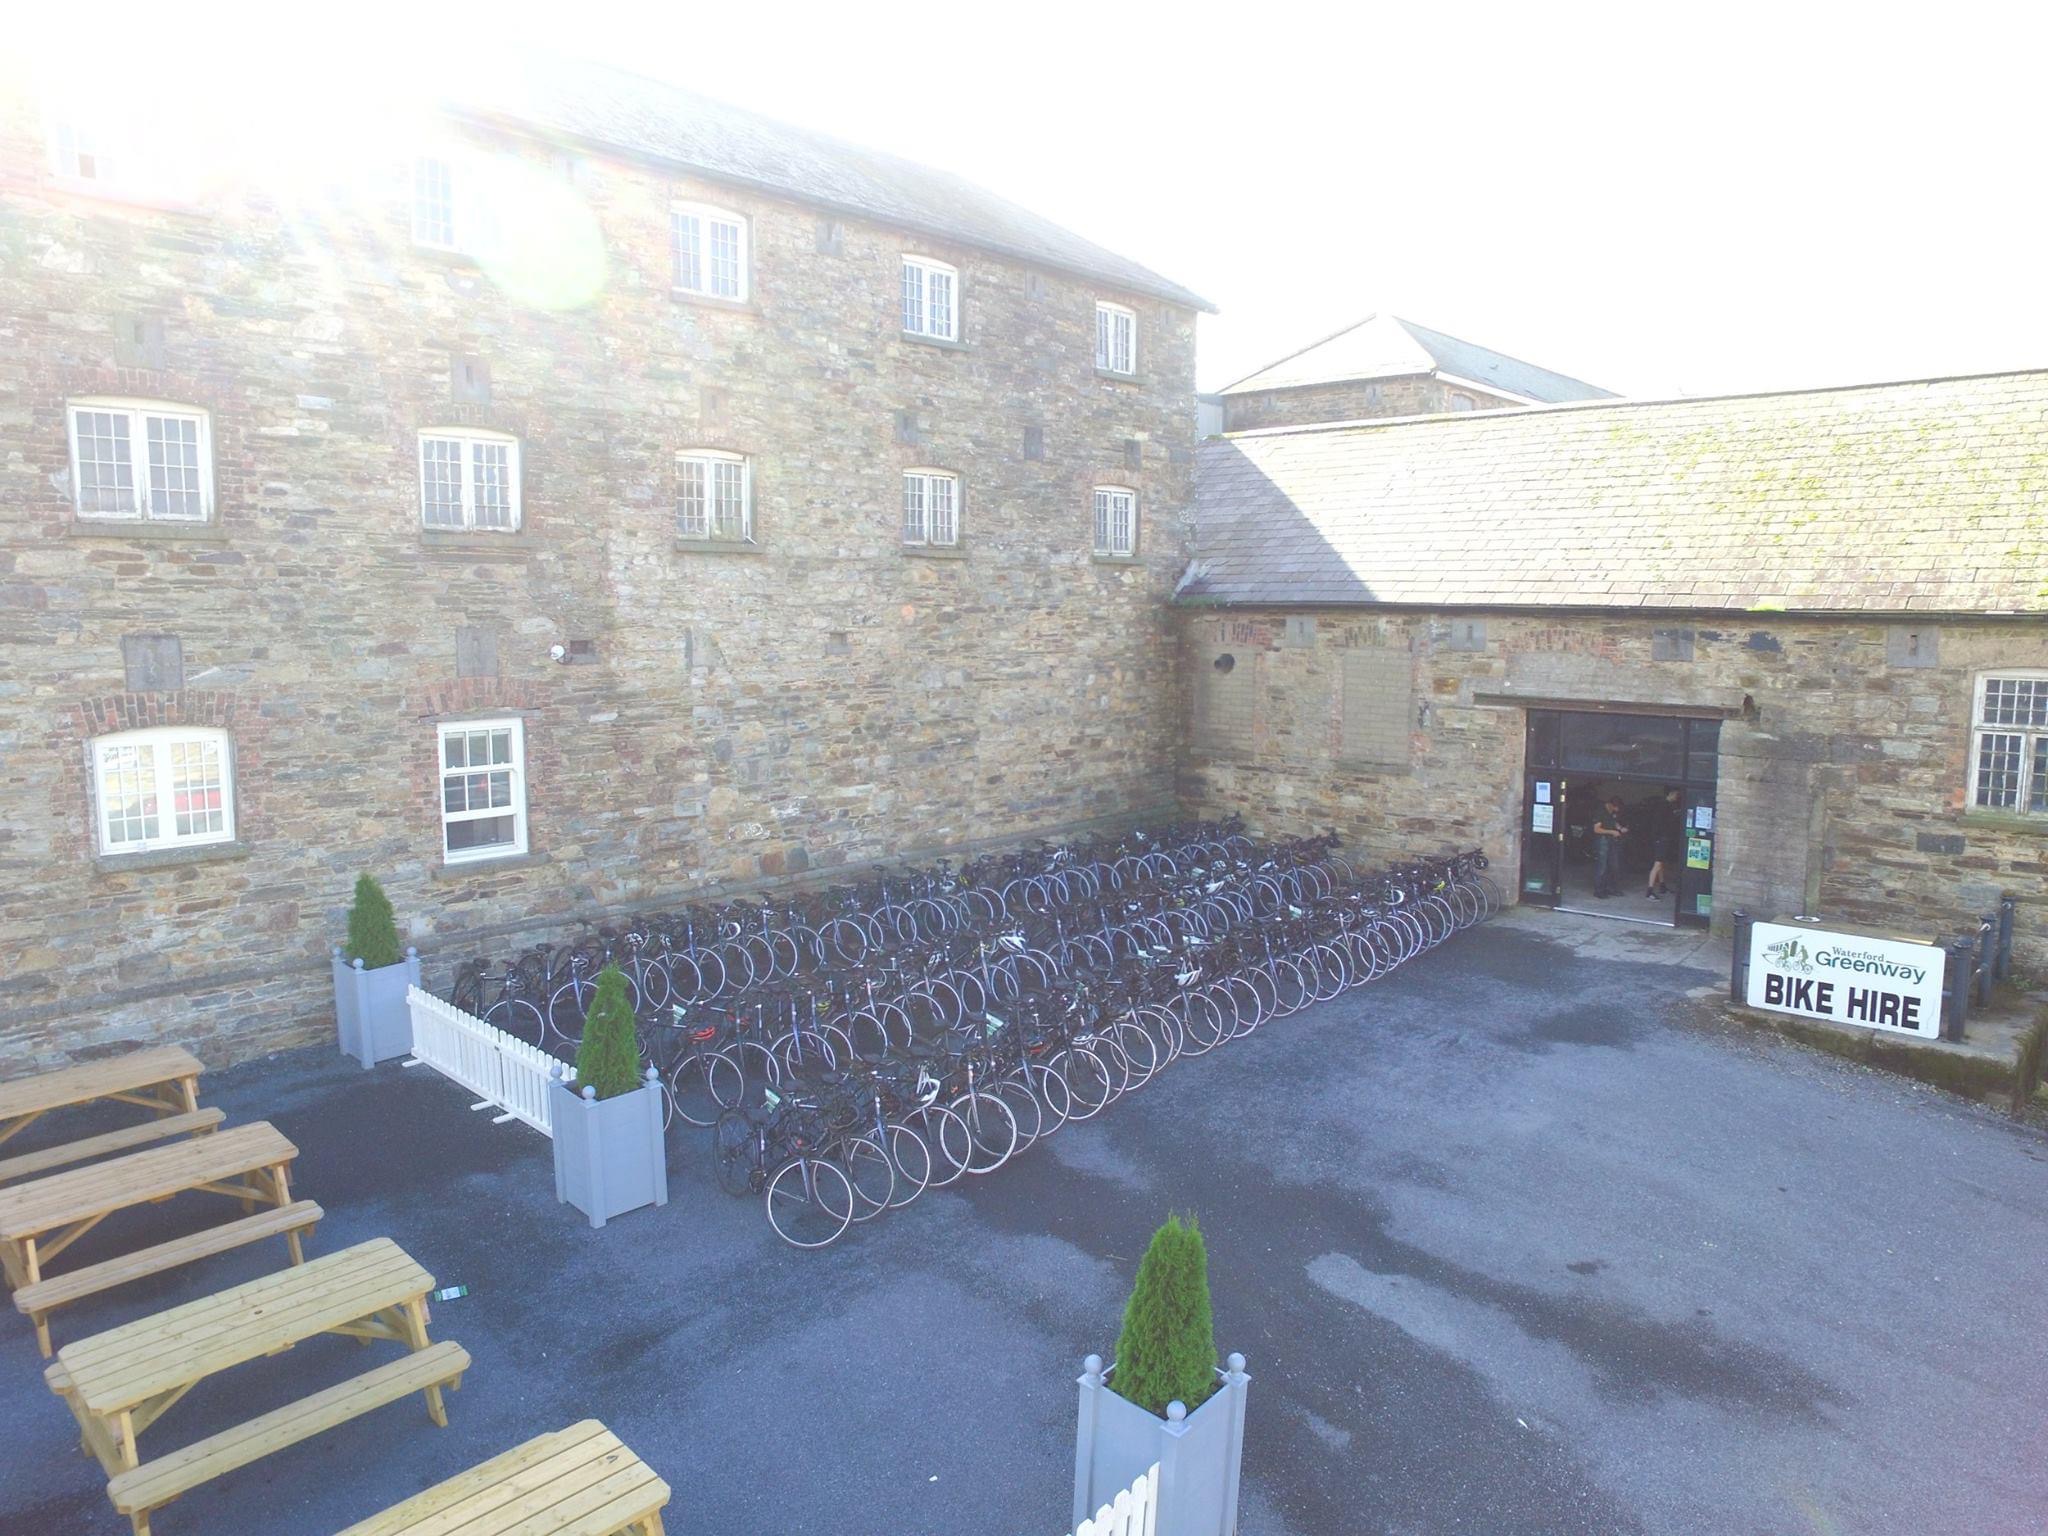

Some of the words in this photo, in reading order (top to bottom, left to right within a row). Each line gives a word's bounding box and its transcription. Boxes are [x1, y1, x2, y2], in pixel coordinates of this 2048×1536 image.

[1815, 951, 1926, 984] Greenway
[1832, 946, 1885, 962] Waterford
[1764, 973, 1834, 1014] BIKE
[1847, 986, 1921, 1030] HIRE
